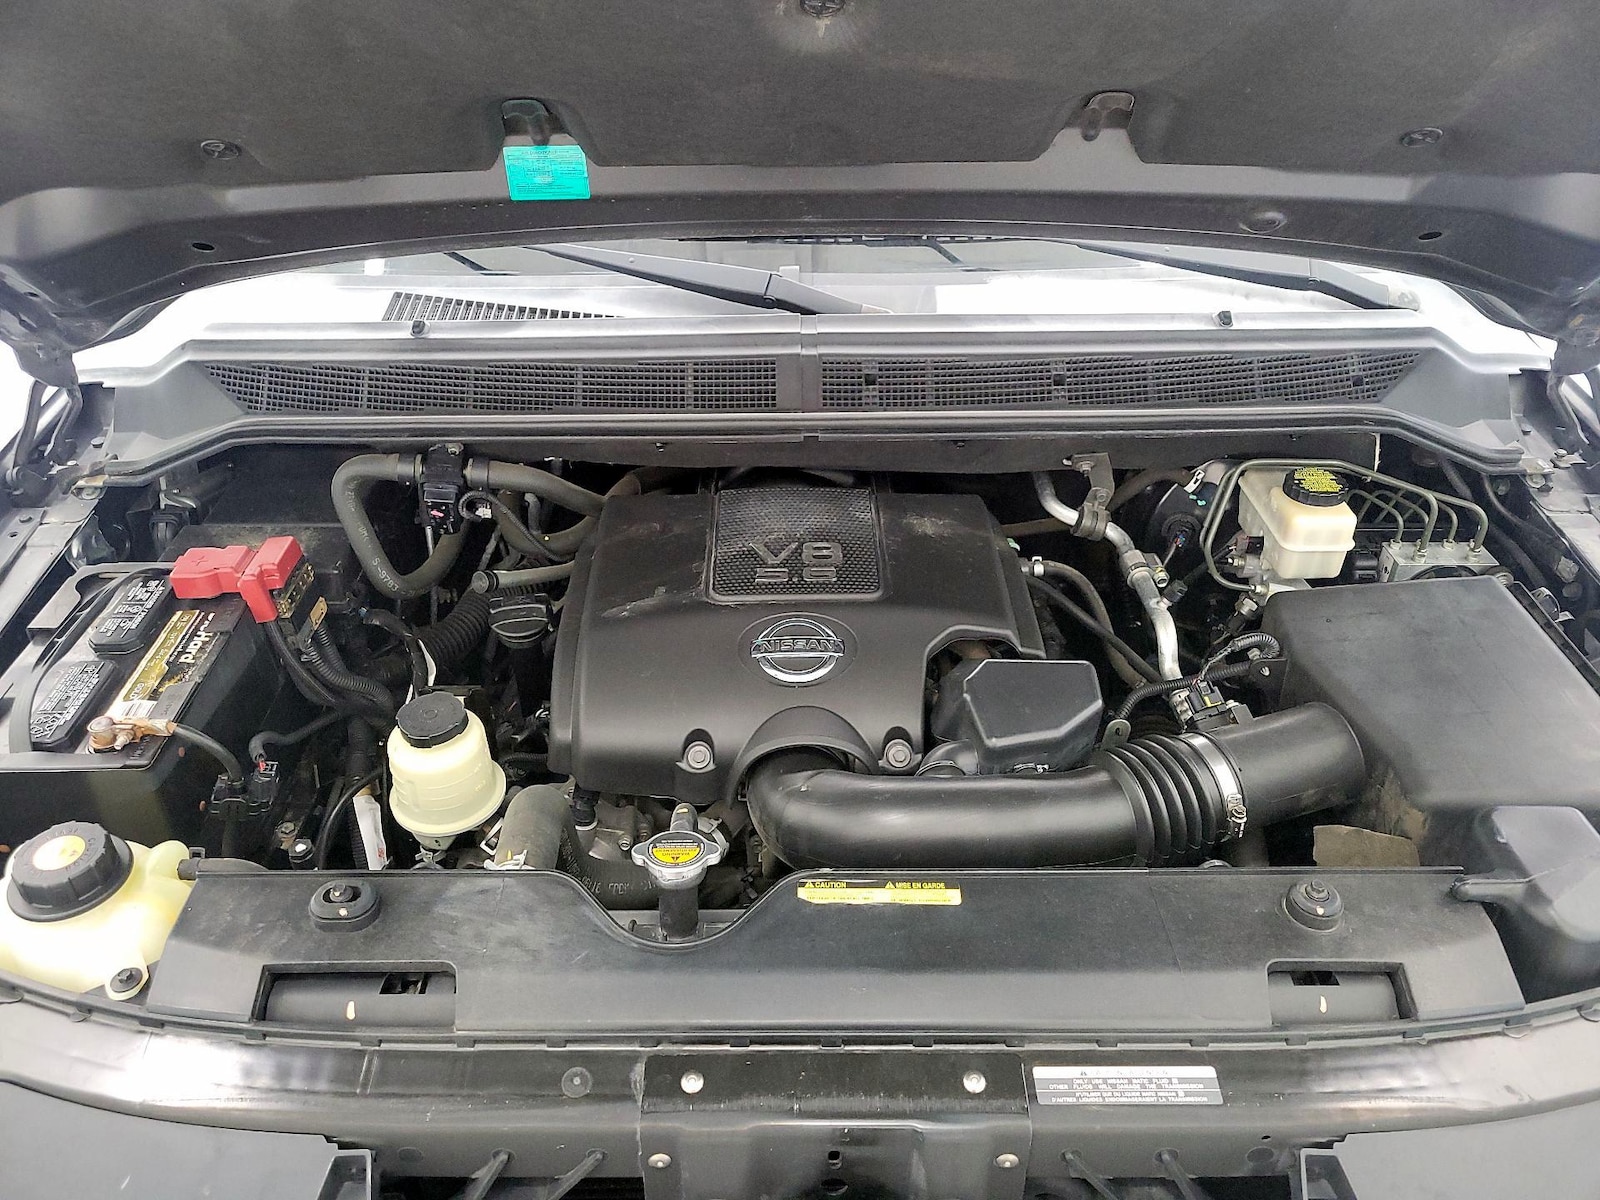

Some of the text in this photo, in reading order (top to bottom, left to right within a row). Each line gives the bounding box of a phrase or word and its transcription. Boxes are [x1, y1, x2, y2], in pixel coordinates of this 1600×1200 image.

[749, 541, 843, 564] V8
[755, 568, 837, 582] 5.6
[761, 640, 834, 651] NISSAN
